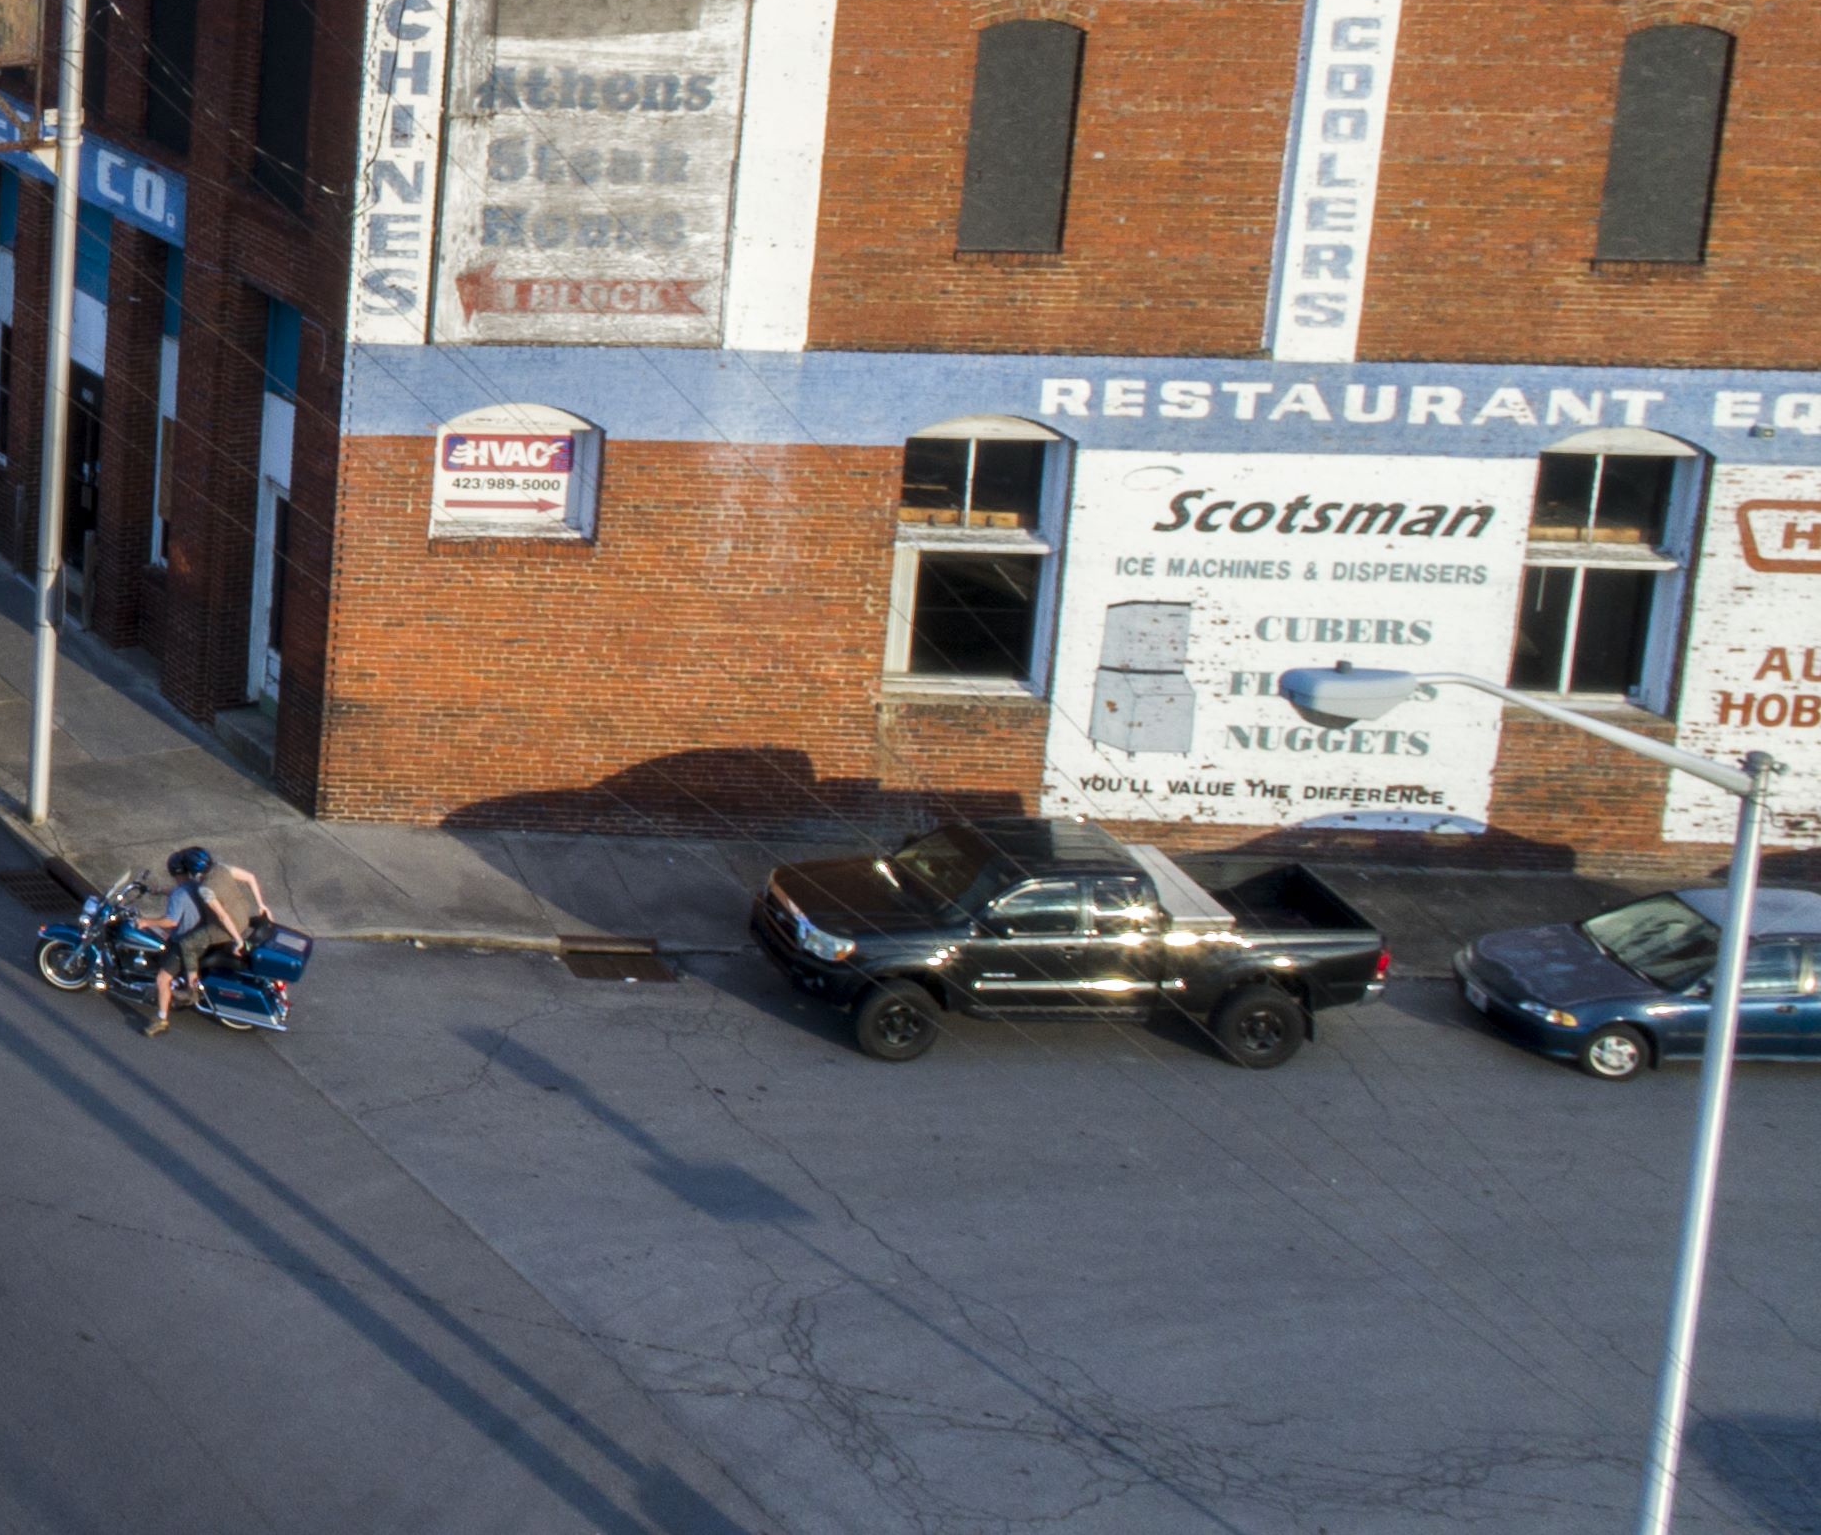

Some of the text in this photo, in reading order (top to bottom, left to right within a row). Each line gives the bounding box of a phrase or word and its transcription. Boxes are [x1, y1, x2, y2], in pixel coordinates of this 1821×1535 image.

[476, 66, 716, 112] Athens
[96, 149, 176, 228] CO.
[1293, 17, 1382, 330] COOLERS
[1040, 378, 1665, 427] RESTAURANT
[467, 439, 553, 468] HVAC
[452, 476, 562, 491] 423/989-5000
[1153, 489, 1497, 539] Scotsman
[1115, 556, 1489, 586] ICE MACHINES & DISPENSERS
[1255, 615, 1433, 646] CUBERS
[1223, 724, 1431, 757] NUGGETS
[1079, 776, 1445, 806] YOU'LL VALUE THE DIFFERENCE
